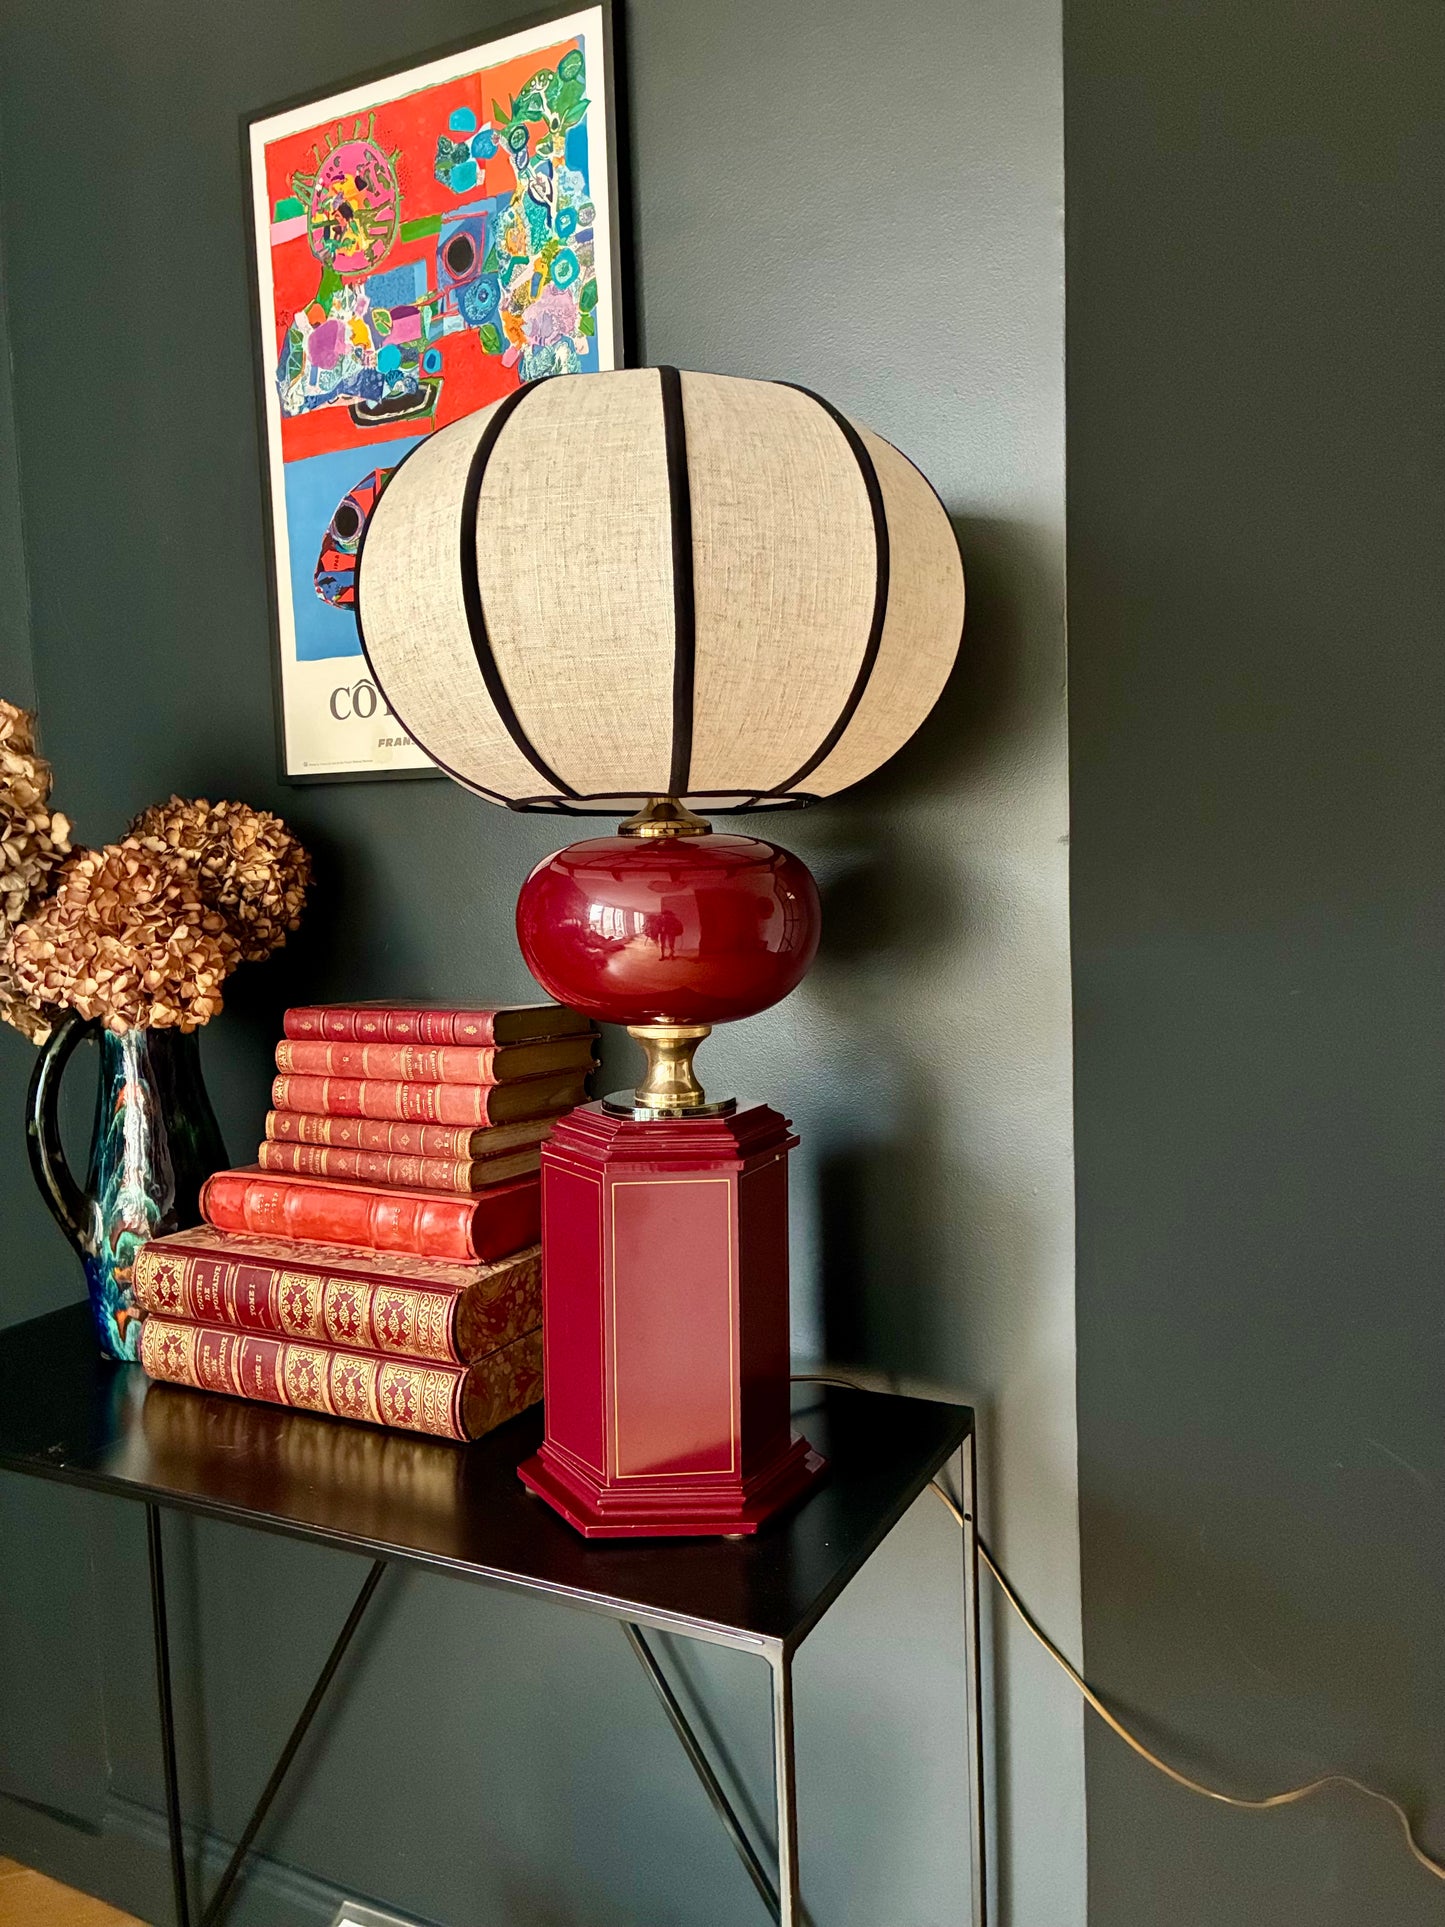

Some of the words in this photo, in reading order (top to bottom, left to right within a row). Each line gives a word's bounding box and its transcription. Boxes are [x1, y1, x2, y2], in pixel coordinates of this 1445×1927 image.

[330, 678, 393, 721] CÔ
[378, 736, 415, 748] FRAN
[196, 1274, 205, 1311] CONTES
[204, 1287, 211, 1301] DE
[212, 1265, 222, 1311] FONTAINE
[248, 1290, 257, 1316] TOME
[203, 1344, 212, 1381] CONTES
[211, 1357, 218, 1372] DE
[218, 1336, 228, 1382] FONTAINE
[255, 1364, 264, 1391] TOME
